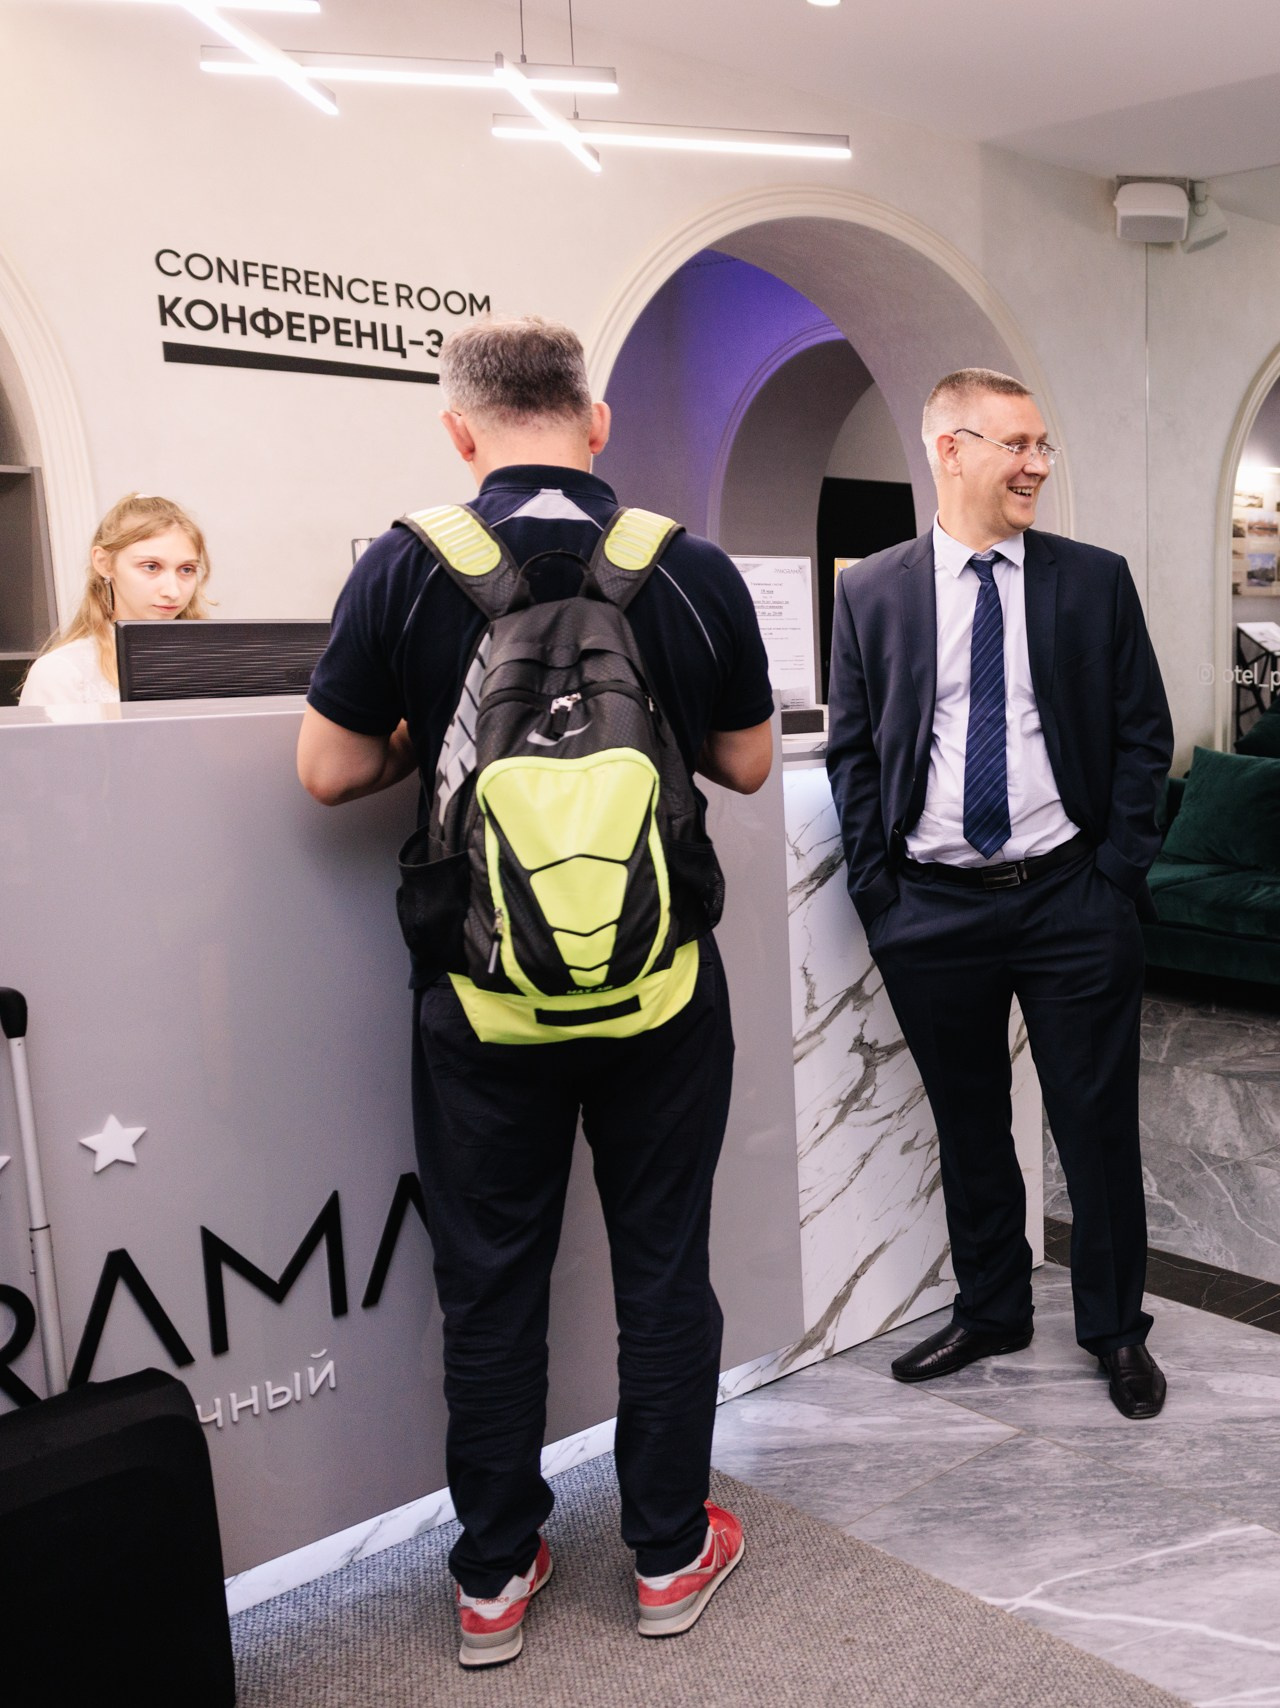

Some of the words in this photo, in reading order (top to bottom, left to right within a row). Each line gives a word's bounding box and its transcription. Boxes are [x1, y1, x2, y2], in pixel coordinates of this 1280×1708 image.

[155, 248, 389, 306] CONFERENCE
[396, 283, 491, 317] ROOM
[158, 294, 445, 359] КОНФЕРЕНЦ-З
[195, 1348, 337, 1429] чный
